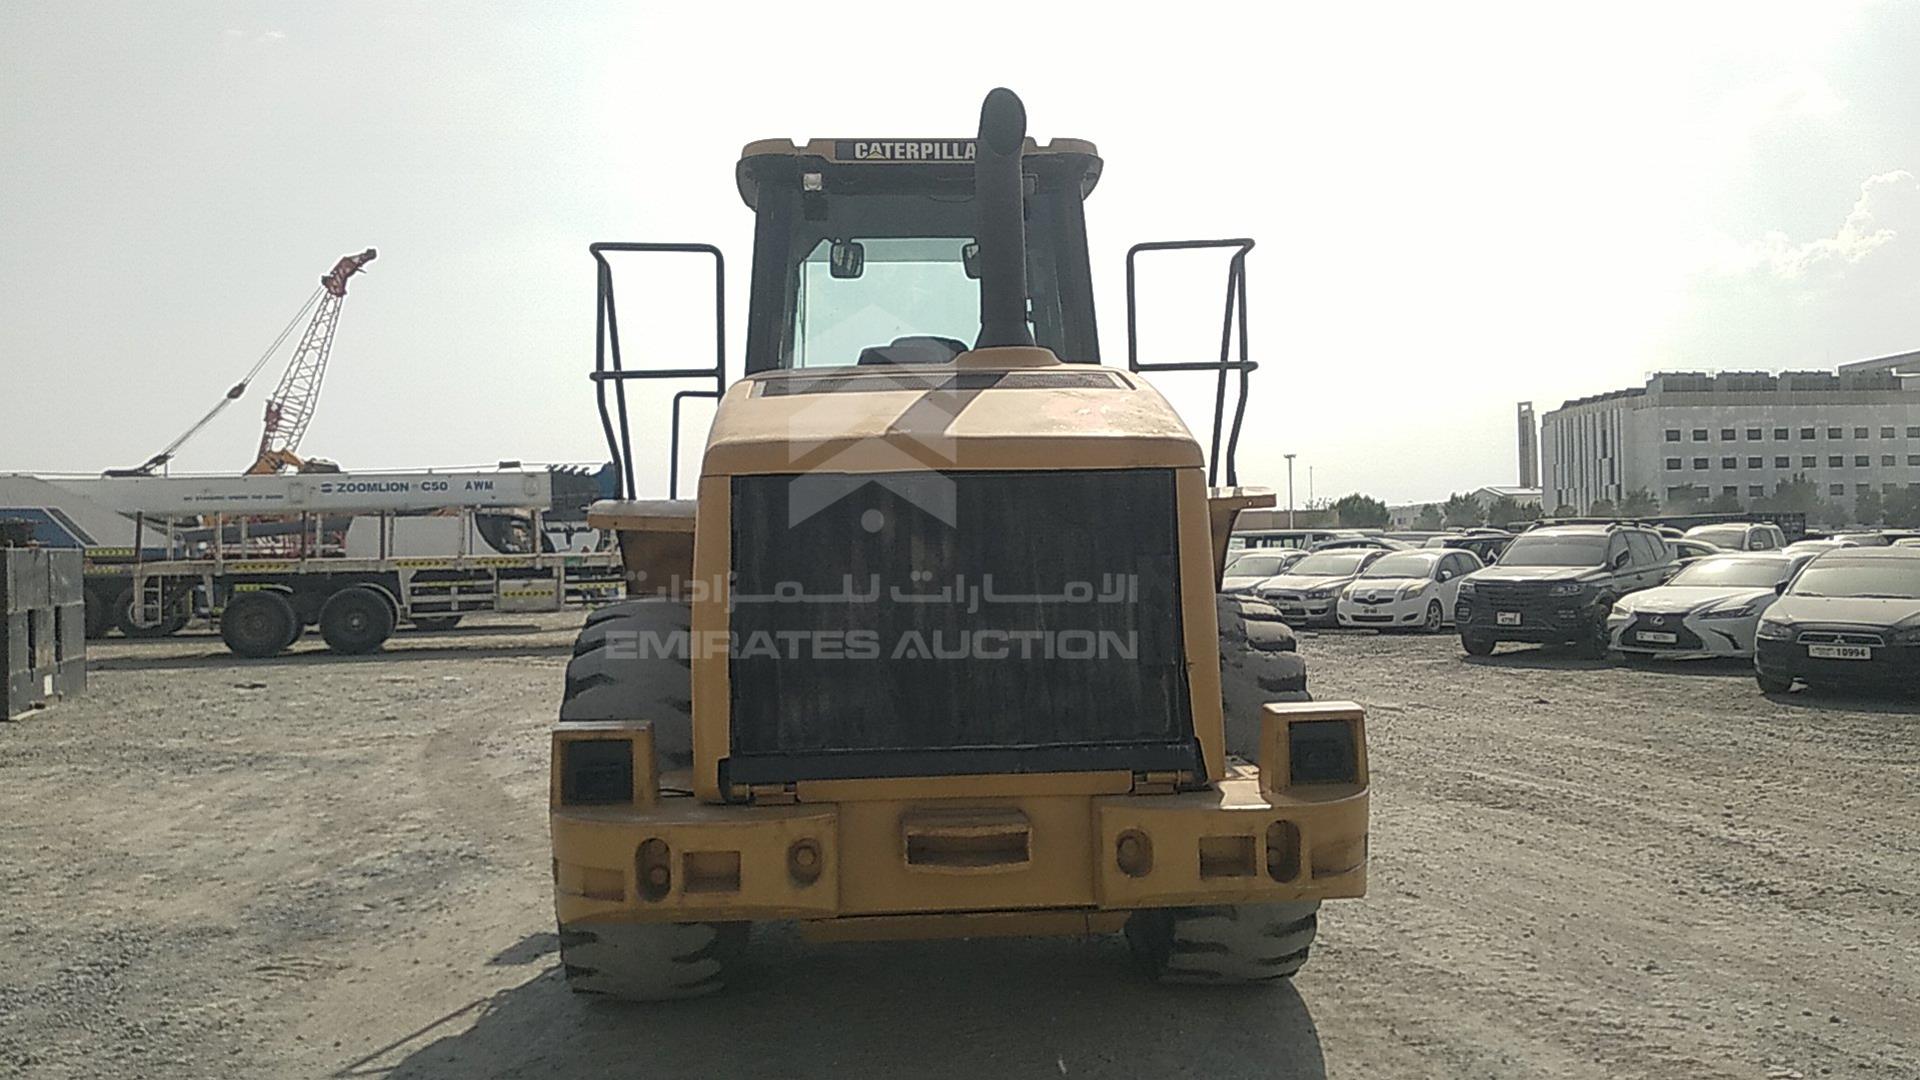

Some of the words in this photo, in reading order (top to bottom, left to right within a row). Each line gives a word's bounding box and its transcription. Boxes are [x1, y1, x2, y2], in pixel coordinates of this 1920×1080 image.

[854, 142, 977, 160] CATERPILLA
[337, 482, 410, 493] ZOOMLION
[420, 480, 449, 492] C50
[464, 480, 494, 491] AWM
